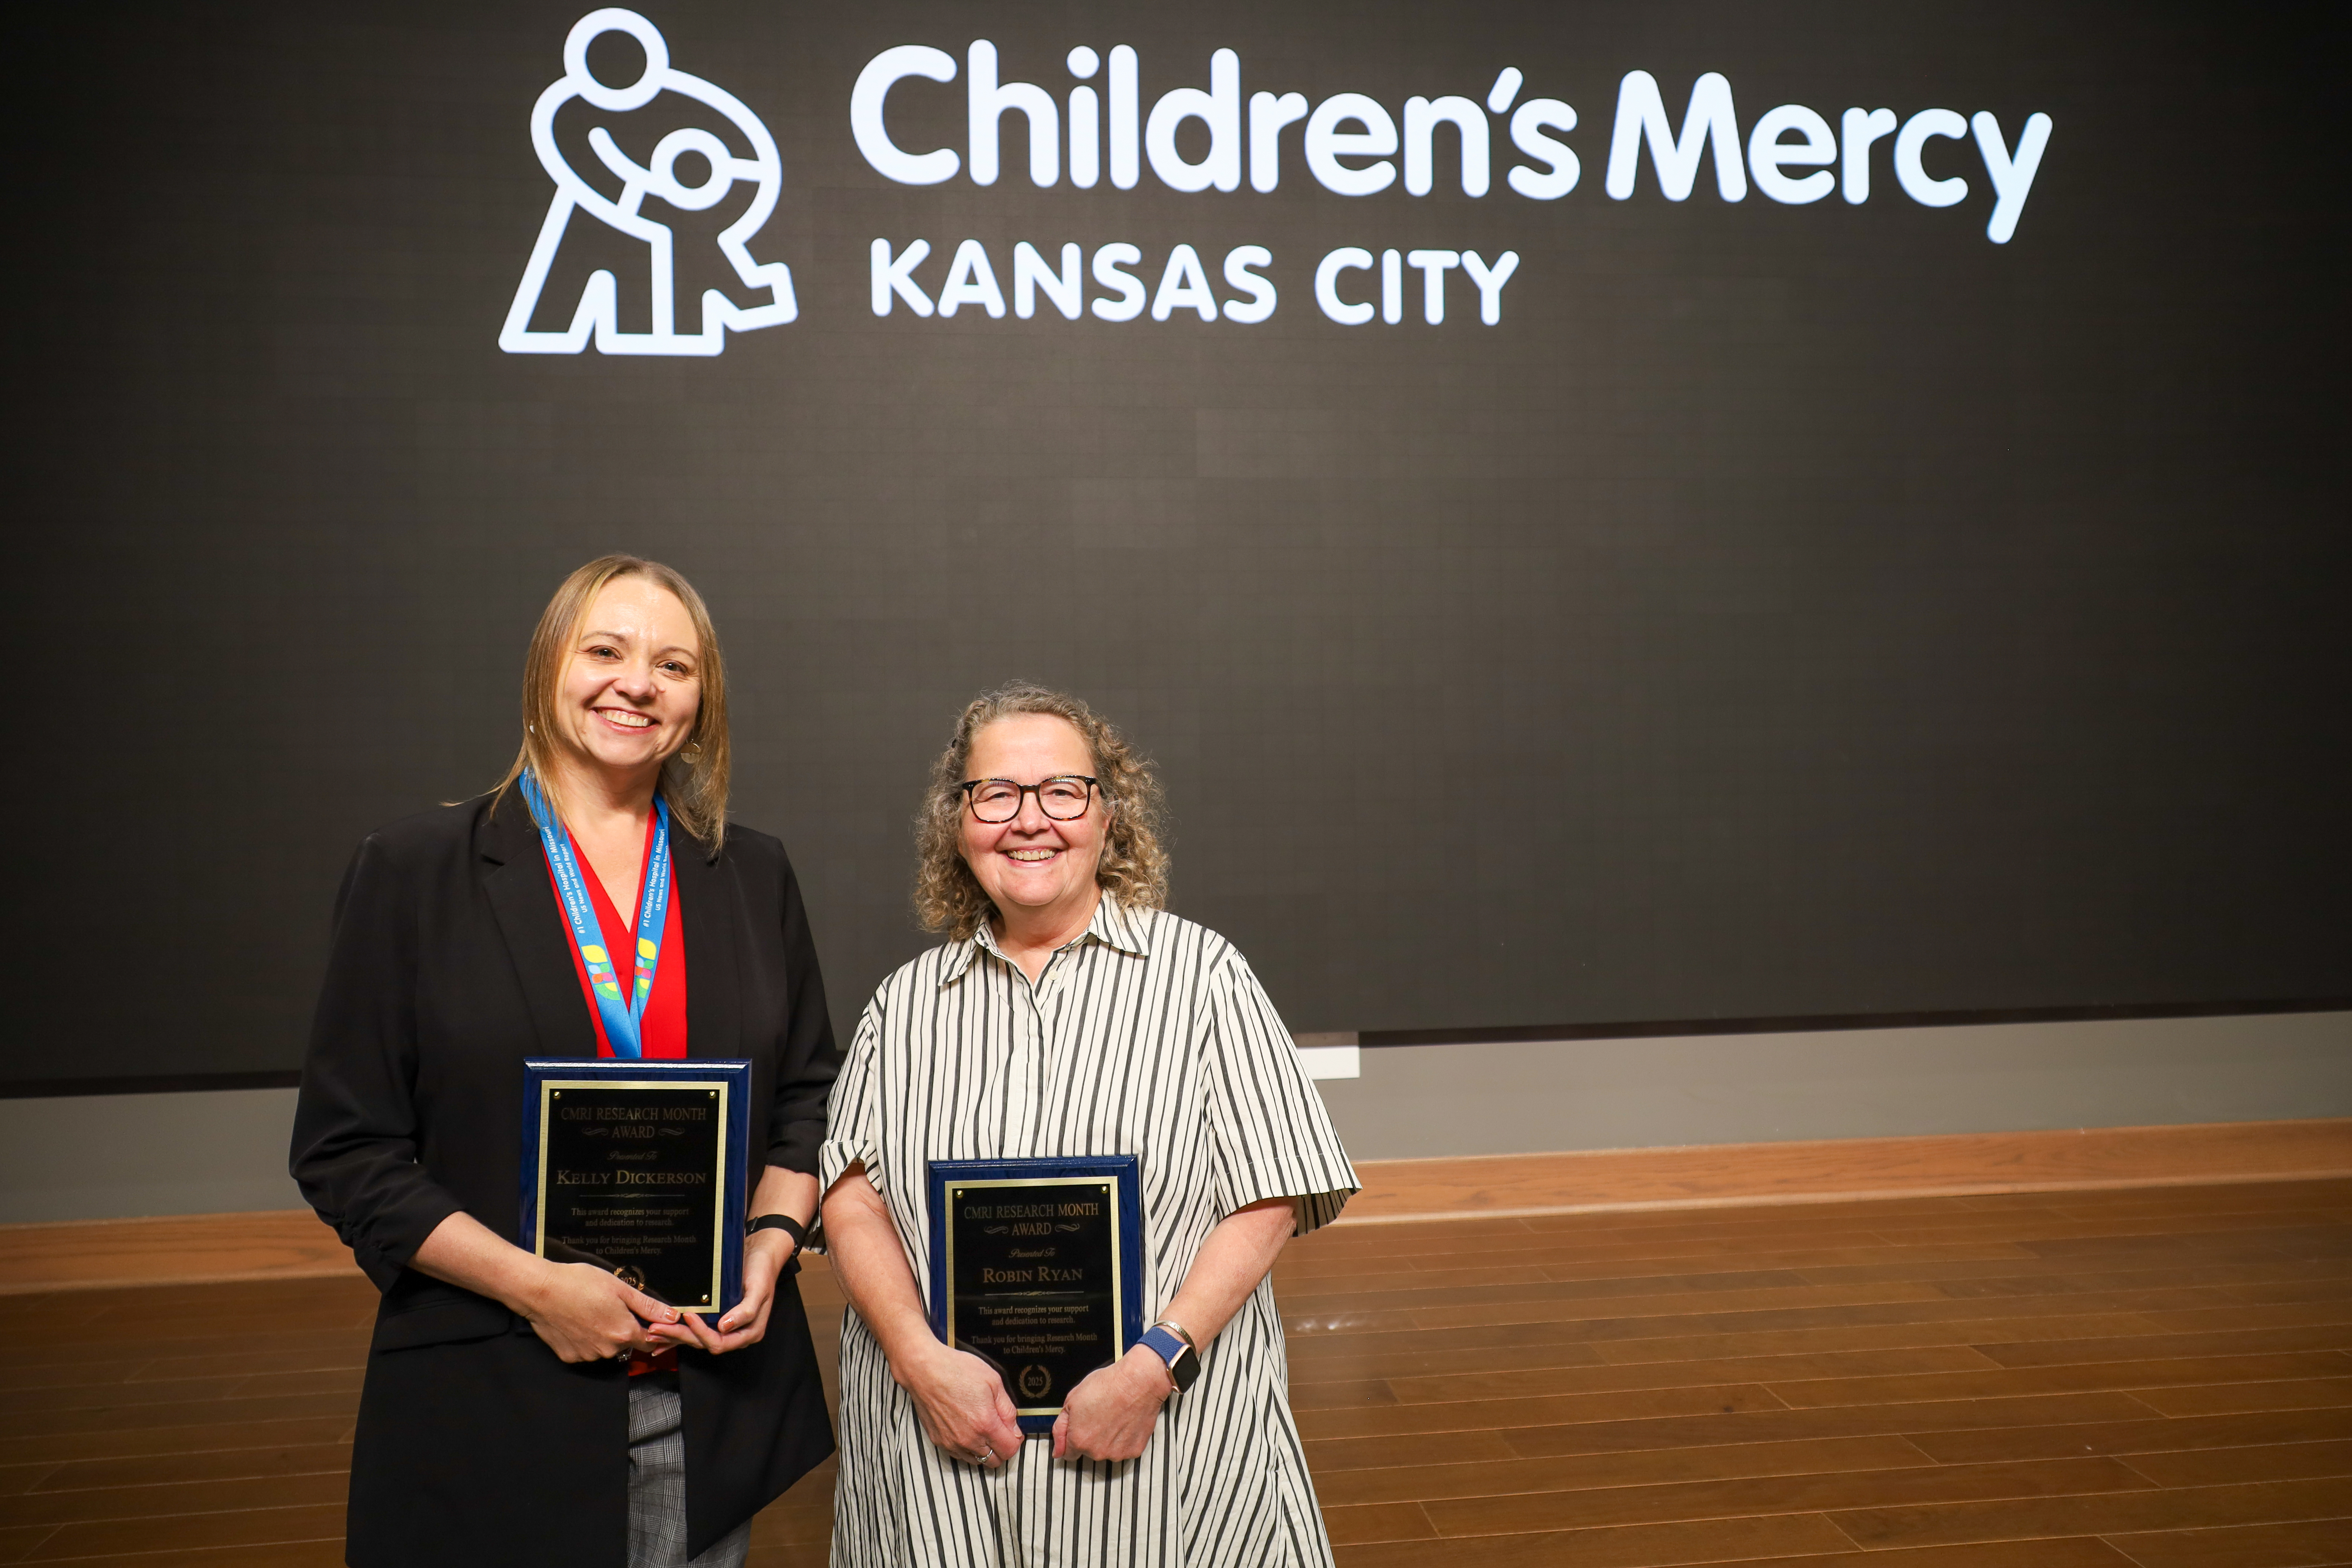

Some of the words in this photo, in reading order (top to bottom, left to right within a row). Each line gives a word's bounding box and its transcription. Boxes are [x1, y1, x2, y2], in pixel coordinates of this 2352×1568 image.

[851, 40, 1580, 199] Children's
[1606, 70, 2052, 243] Mercy
[871, 238, 1276, 323] KANSAS
[1315, 248, 1519, 325] CITY
[542, 827, 557, 853] Missouri
[655, 829, 665, 854] Missouri
[559, 844, 570, 861] Report
[565, 862, 576, 877] World
[649, 862, 659, 887] Hospital
[555, 863, 570, 890] Hospital
[571, 878, 579, 888] and
[576, 890, 585, 904] News
[644, 888, 655, 918] Children's
[566, 891, 582, 925] Children's
[561, 1108, 591, 1120] CMRI
[597, 1108, 658, 1120] RESEARCH
[663, 1108, 706, 1120] MONTH
[612, 1126, 655, 1138] AWARD
[607, 1151, 644, 1161] Presented
[646, 1151, 658, 1160] To
[610, 1207, 644, 1217] recognizes
[663, 1208, 689, 1216] support
[964, 1206, 992, 1219] CMRI
[997, 1205, 1054, 1218] RESEARCH
[1058, 1203, 1099, 1216] MONTH
[1012, 1222, 1051, 1236] AWARD
[612, 1236, 641, 1245] bringing
[640, 1246, 662, 1255] Mercy.
[1009, 1249, 1043, 1258] Presented
[1044, 1248, 1055, 1257] To
[1015, 1305, 1046, 1315] recognizes
[1064, 1305, 1089, 1314] support
[992, 1317, 1003, 1326] and
[1005, 1317, 1038, 1325] dedication
[1048, 1315, 1075, 1324] research.
[972, 1336, 992, 1344] Thank
[1017, 1334, 1045, 1344] bringing
[1046, 1334, 1074, 1342] Research
[1012, 1345, 1043, 1354] Children's
[1045, 1345, 1065, 1354] Mercy.
[1027, 1377, 1043, 1386] 2025
